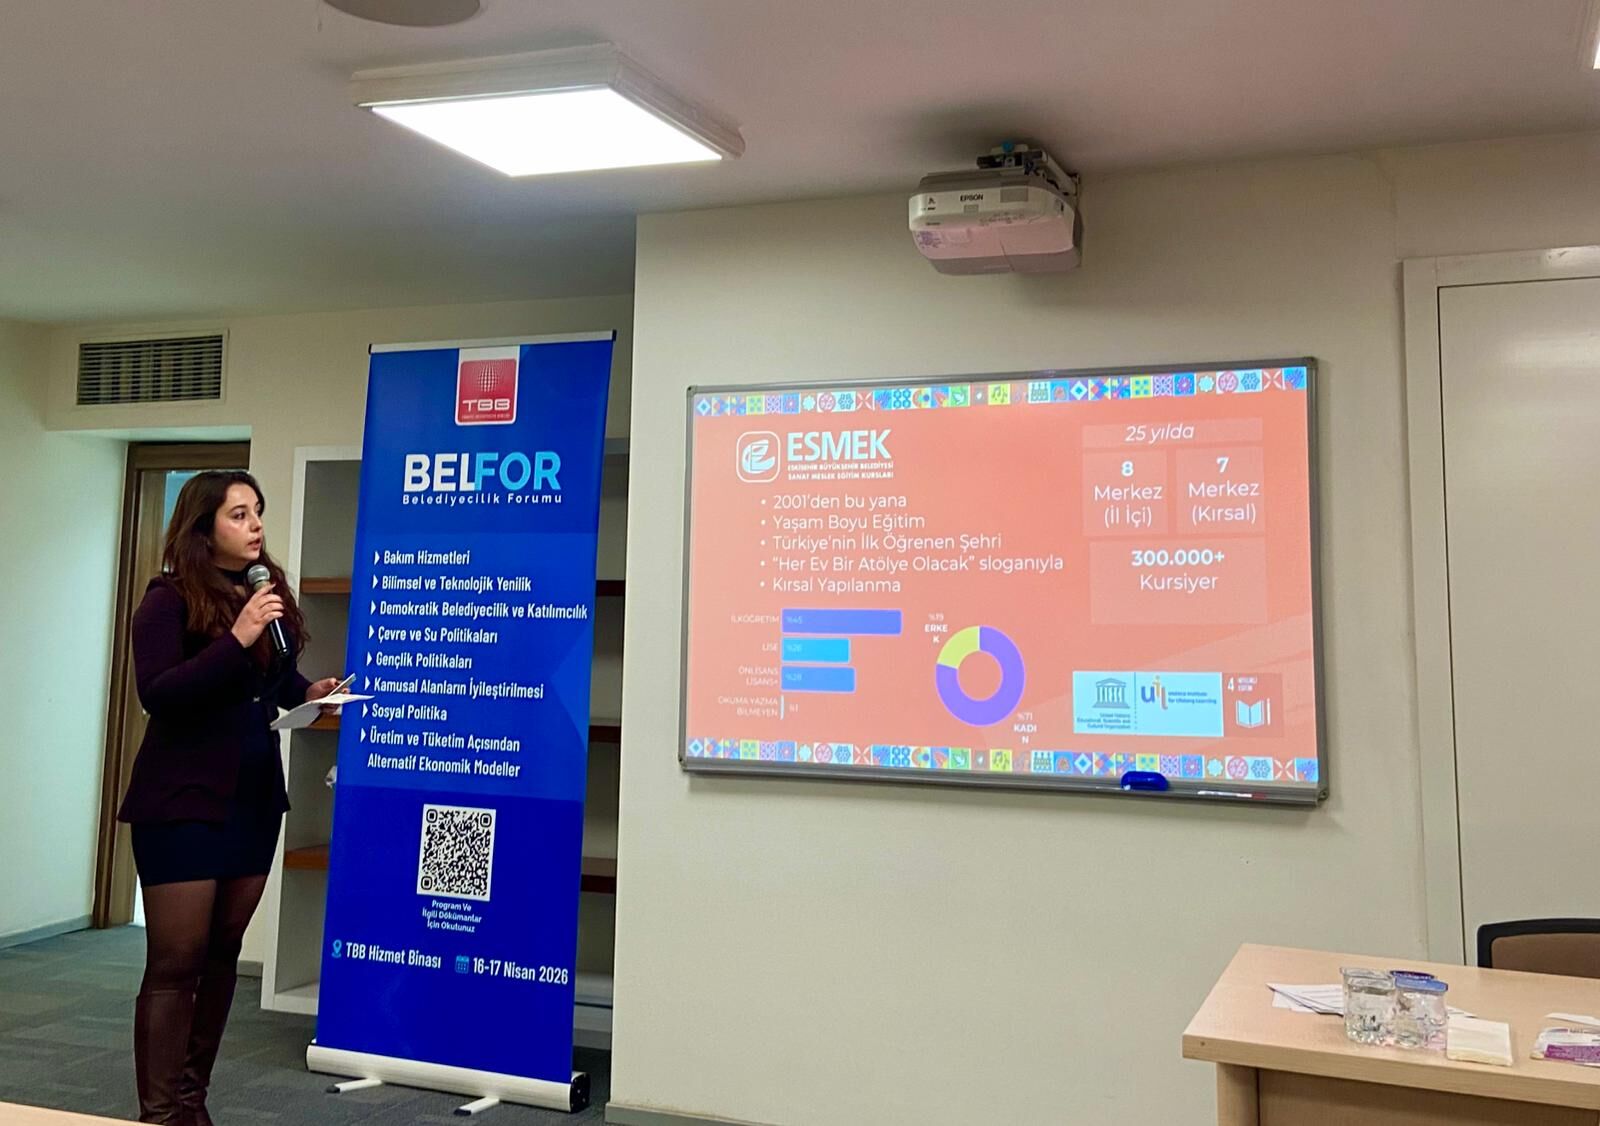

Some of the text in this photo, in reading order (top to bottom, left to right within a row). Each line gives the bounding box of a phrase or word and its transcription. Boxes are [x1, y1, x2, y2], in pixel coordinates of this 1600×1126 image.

[462, 398, 510, 412] TBB
[1124, 424, 1195, 444] 25 yılda
[787, 429, 892, 462] ESMEK
[403, 451, 562, 492] BELFOR
[1121, 460, 1134, 477] 8
[1216, 456, 1230, 473] 7
[1094, 485, 1163, 501] Merkez
[1188, 480, 1260, 497] Merkez
[402, 493, 562, 506] Belediyecilik Forumu
[773, 493, 907, 511] 2001'den bu yana
[773, 514, 925, 532] Yaşam Boyu Eğitim
[1191, 503, 1257, 526] (Kırsal)
[773, 532, 1002, 553] Türkiye'nin İlk Öğrenen Şehri
[384, 550, 470, 565] Bakım Hizmetleri
[809, 556, 829, 571] Ev
[833, 555, 854, 571] Bir
[858, 555, 909, 574] Atölye
[978, 555, 1064, 574] sloganıyla
[1131, 549, 1225, 567] 300.000+
[382, 575, 532, 594] Bilimsel ve Teknolojik Yenilik
[773, 577, 901, 595] Kırsal Yapılanma
[1139, 573, 1219, 593] Kursiyer
[379, 601, 588, 620] Demokratik Belediyecilik ve Katılımcılık
[378, 626, 498, 644] Çevre ve Su Politikaları
[375, 652, 473, 670] Gençlik Politikaları
[373, 677, 544, 699] Kamusal Alanların İyileştirilmesi
[371, 703, 448, 722] Sosyal Politika
[369, 726, 520, 752] Üretim ve Tüketim Açısından
[1021, 735, 1029, 744] N
[367, 753, 521, 778] Alternatif Ekonomik Modeller
[431, 899, 472, 912] Program Ve
[438, 911, 482, 923] Dökümanlar
[441, 920, 476, 933] Okutunuz
[346, 942, 442, 969] TBB Hizmet Binası
[473, 956, 569, 985] 16-17 Nisan 2026
